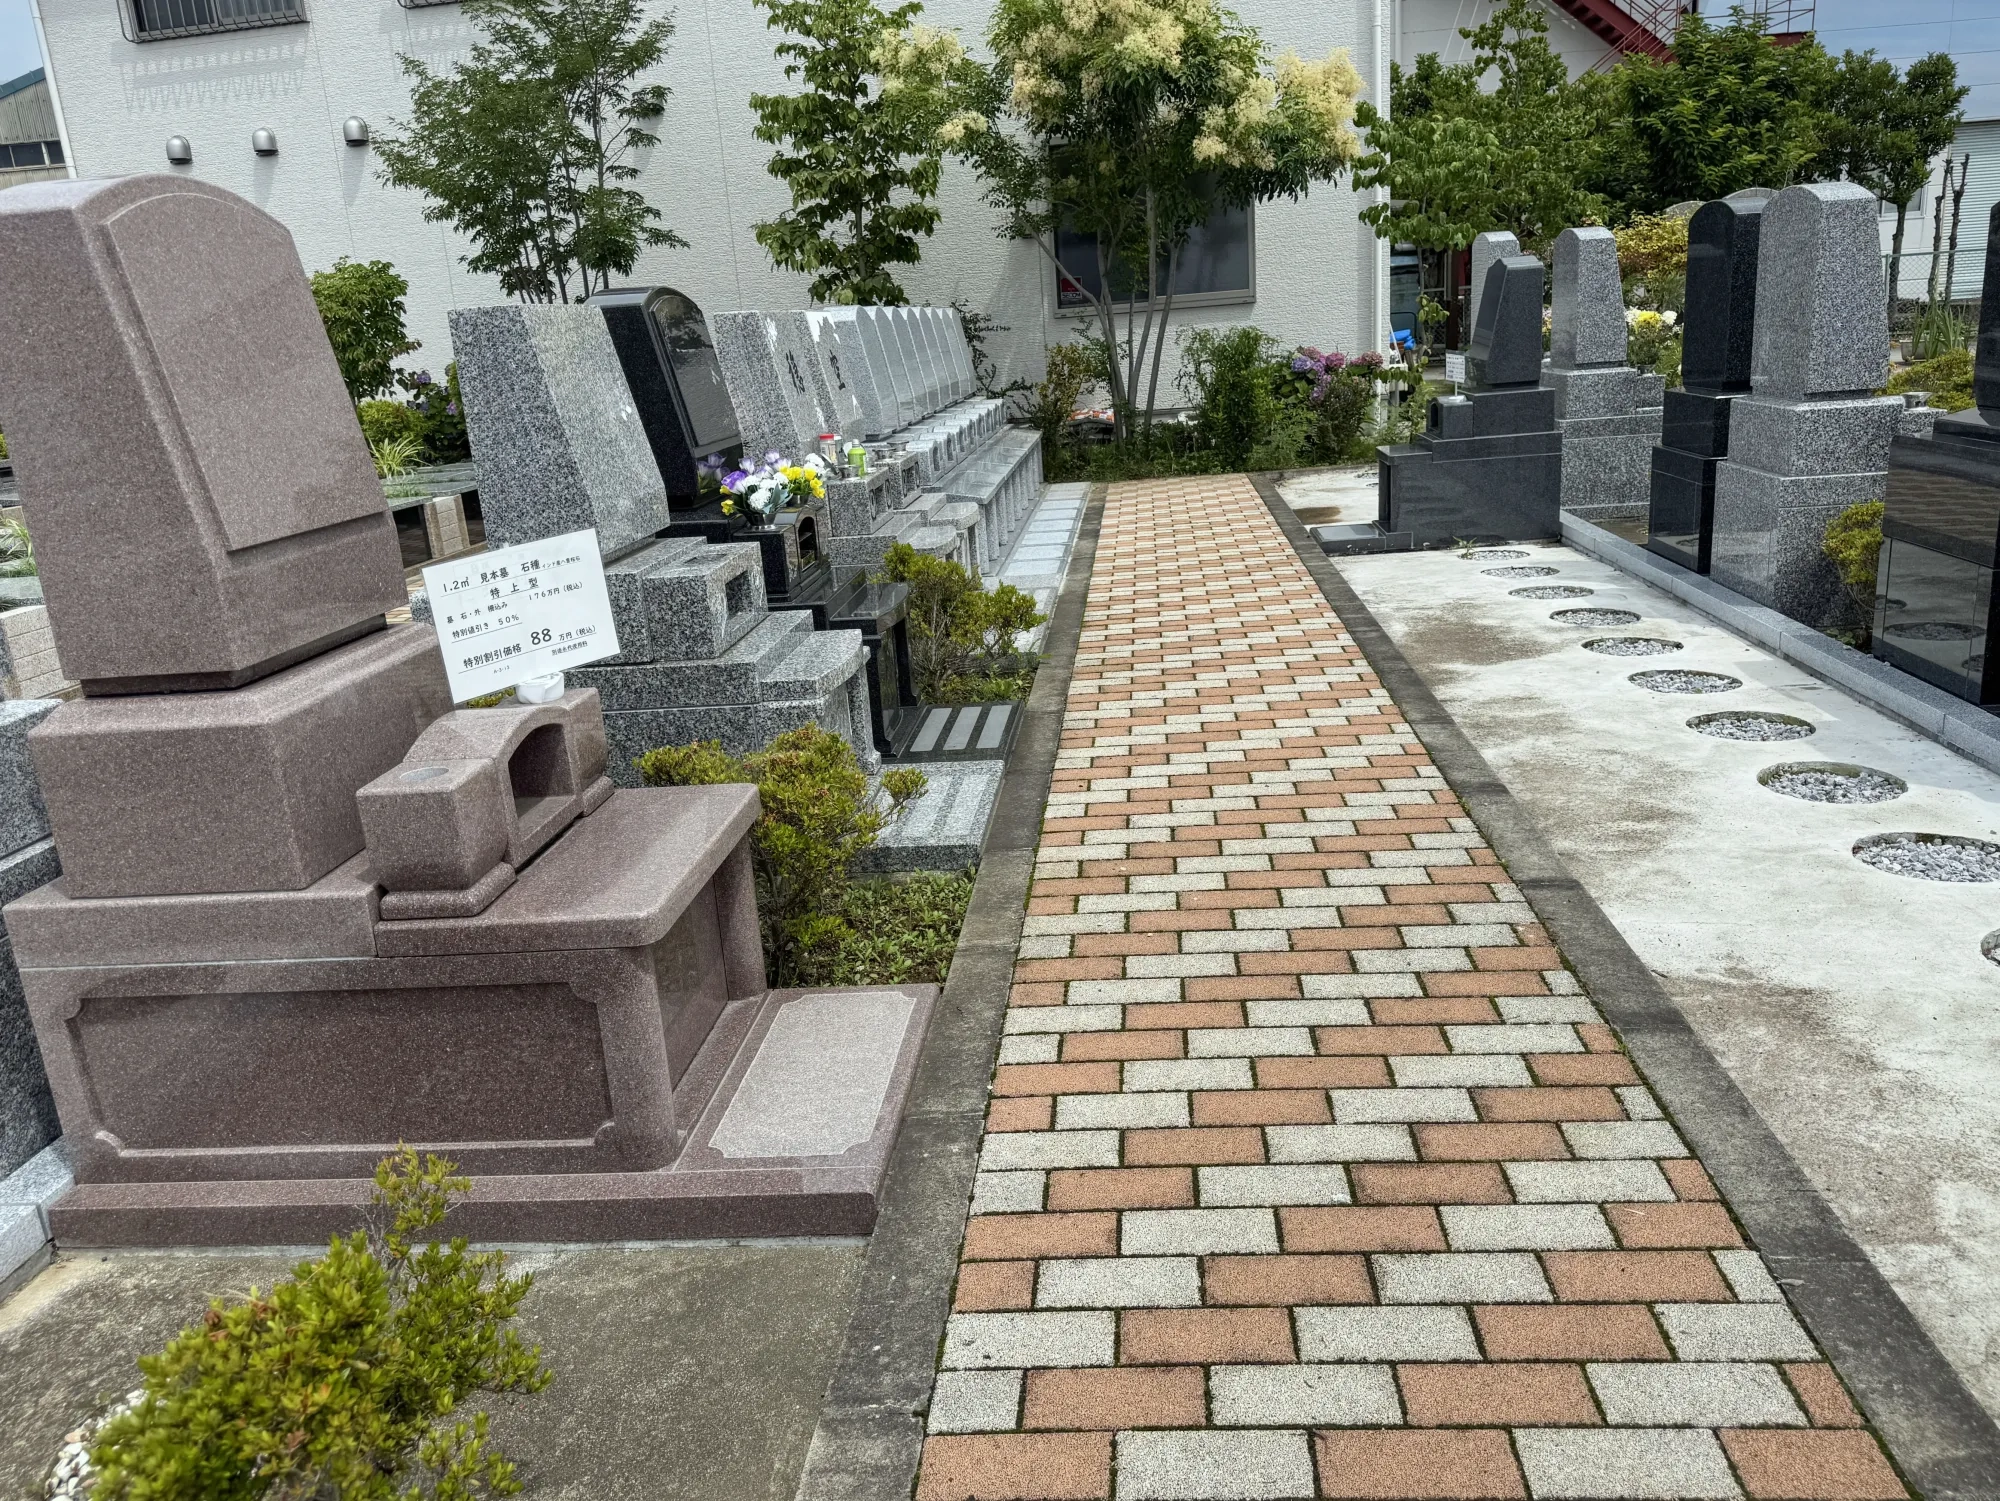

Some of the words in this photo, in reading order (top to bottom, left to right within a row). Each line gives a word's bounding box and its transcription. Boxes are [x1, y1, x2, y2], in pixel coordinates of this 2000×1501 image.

[480, 567, 509, 584] 見本墓
[452, 622, 489, 640] 特別値引き
[463, 643, 522, 669] 特別割引価格
[530, 628, 552, 646] 88
